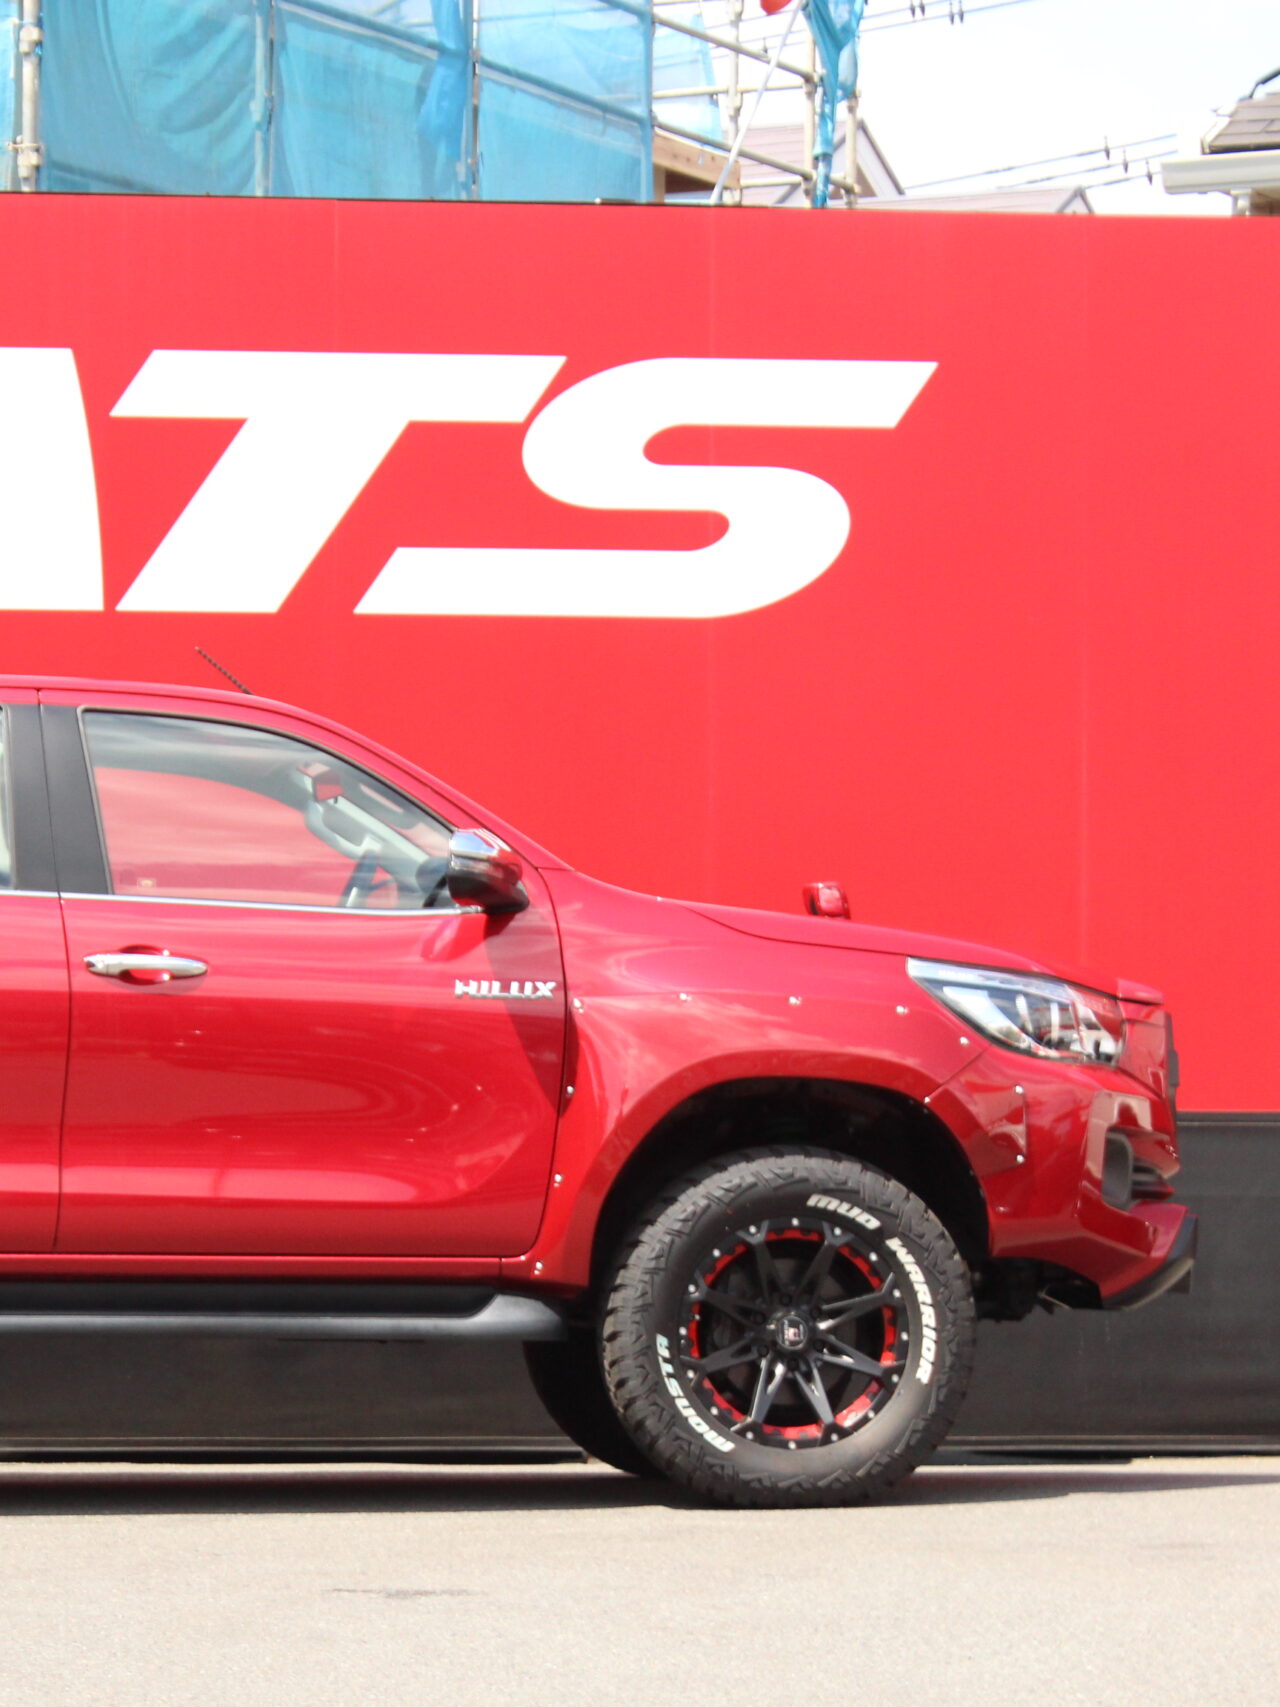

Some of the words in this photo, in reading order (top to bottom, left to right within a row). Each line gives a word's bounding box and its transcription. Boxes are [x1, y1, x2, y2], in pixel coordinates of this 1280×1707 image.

[455, 980, 556, 998] HILUX
[807, 1194, 881, 1229] MUD
[885, 1236, 937, 1384] WARRIOR
[656, 1333, 735, 1452] MONSTA
